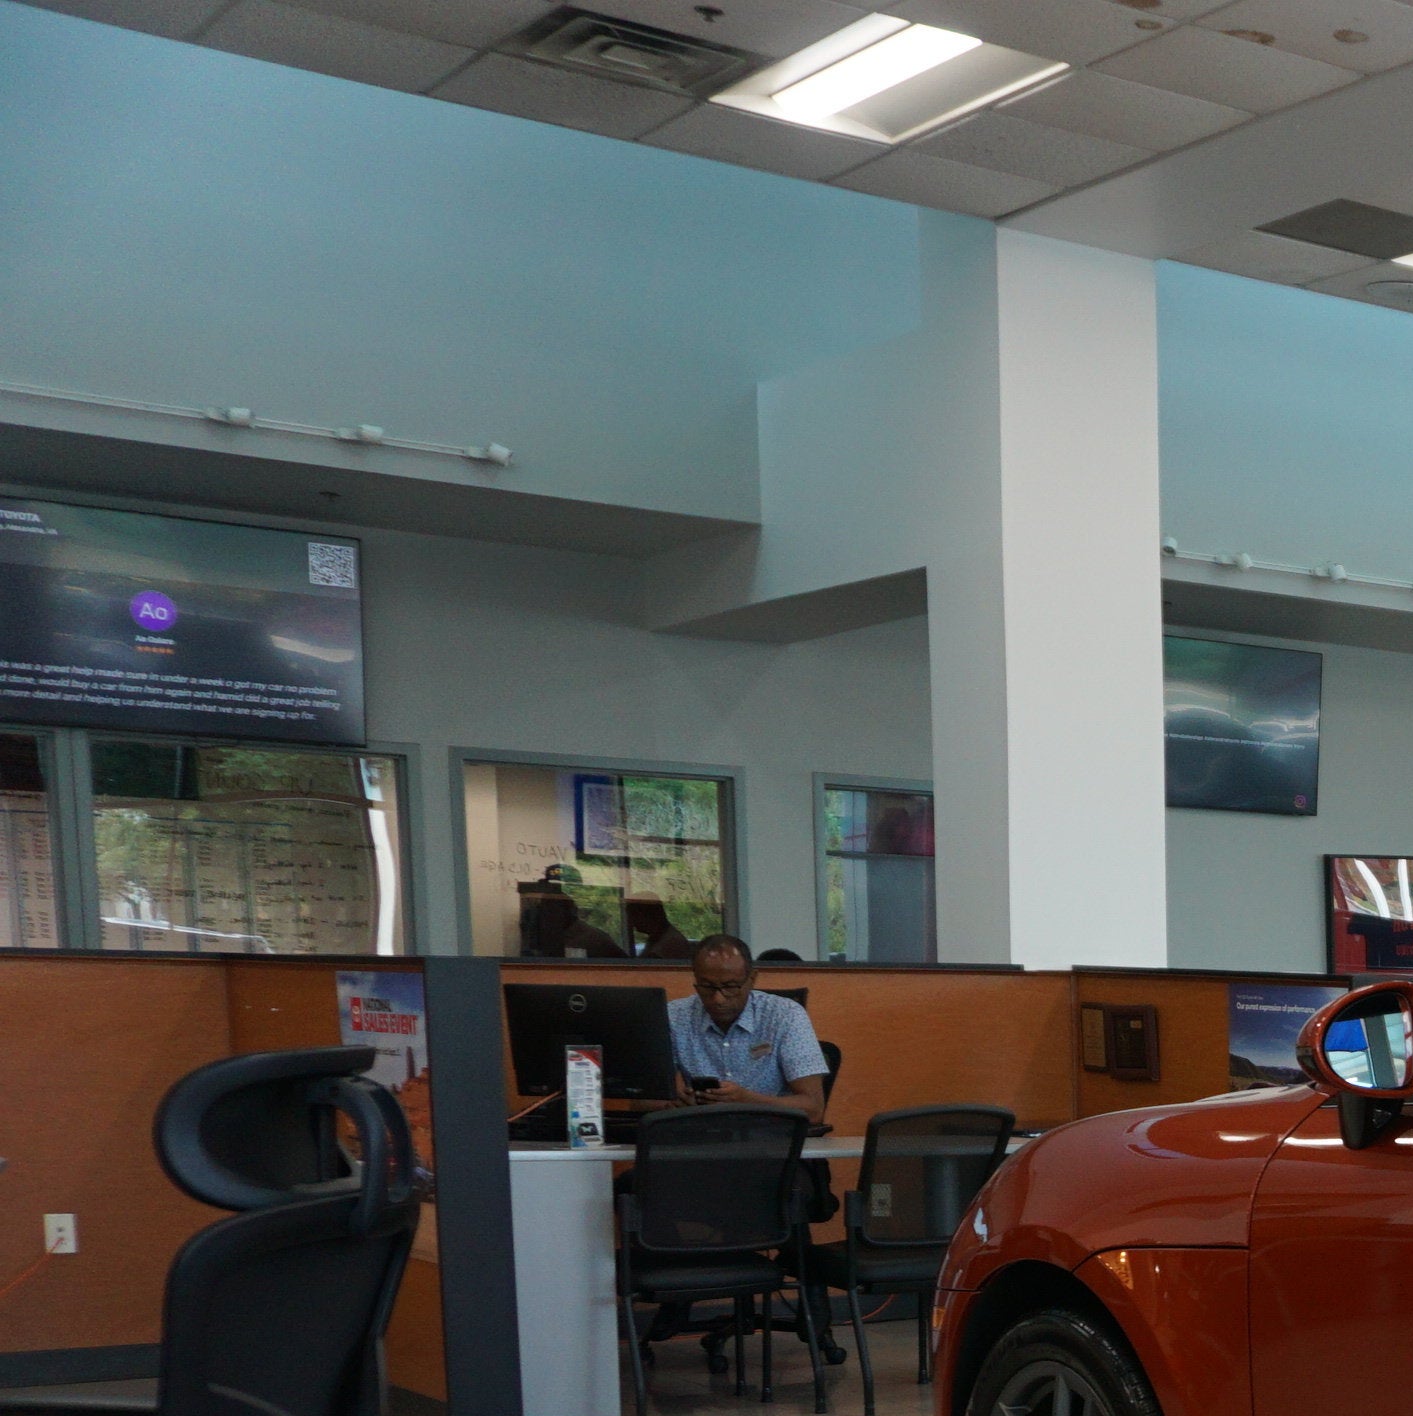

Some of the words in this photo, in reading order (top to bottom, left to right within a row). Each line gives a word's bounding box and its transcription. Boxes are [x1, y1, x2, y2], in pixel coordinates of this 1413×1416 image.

[38, 677, 70, 687] would
[71, 679, 91, 690] buy
[99, 683, 118, 692] car
[118, 682, 143, 693] from
[143, 685, 163, 695] him
[164, 687, 192, 698] again
[192, 690, 213, 699] and
[244, 693, 261, 703] did
[269, 696, 295, 707] great
[295, 698, 311, 708] job
[43, 665, 70, 675] great
[71, 666, 94, 677] help
[95, 669, 124, 678] made
[125, 671, 147, 680] sure
[160, 674, 188, 684] under
[198, 676, 225, 687] week
[234, 680, 251, 690] got
[251, 683, 267, 693] my
[267, 682, 284, 692] car
[284, 685, 298, 693] no
[298, 686, 337, 697] problem
[62, 693, 83, 702] and
[83, 693, 121, 707] helping
[121, 698, 136, 707] us
[136, 698, 192, 711] understand
[192, 702, 217, 713] what
[217, 706, 233, 714] we
[233, 707, 250, 715] are
[251, 707, 286, 719] signing
[286, 711, 300, 720] up
[1259, 1003, 1282, 1013] expression
[362, 1012, 388, 1033] SALES
[388, 1014, 418, 1037] EVENT
